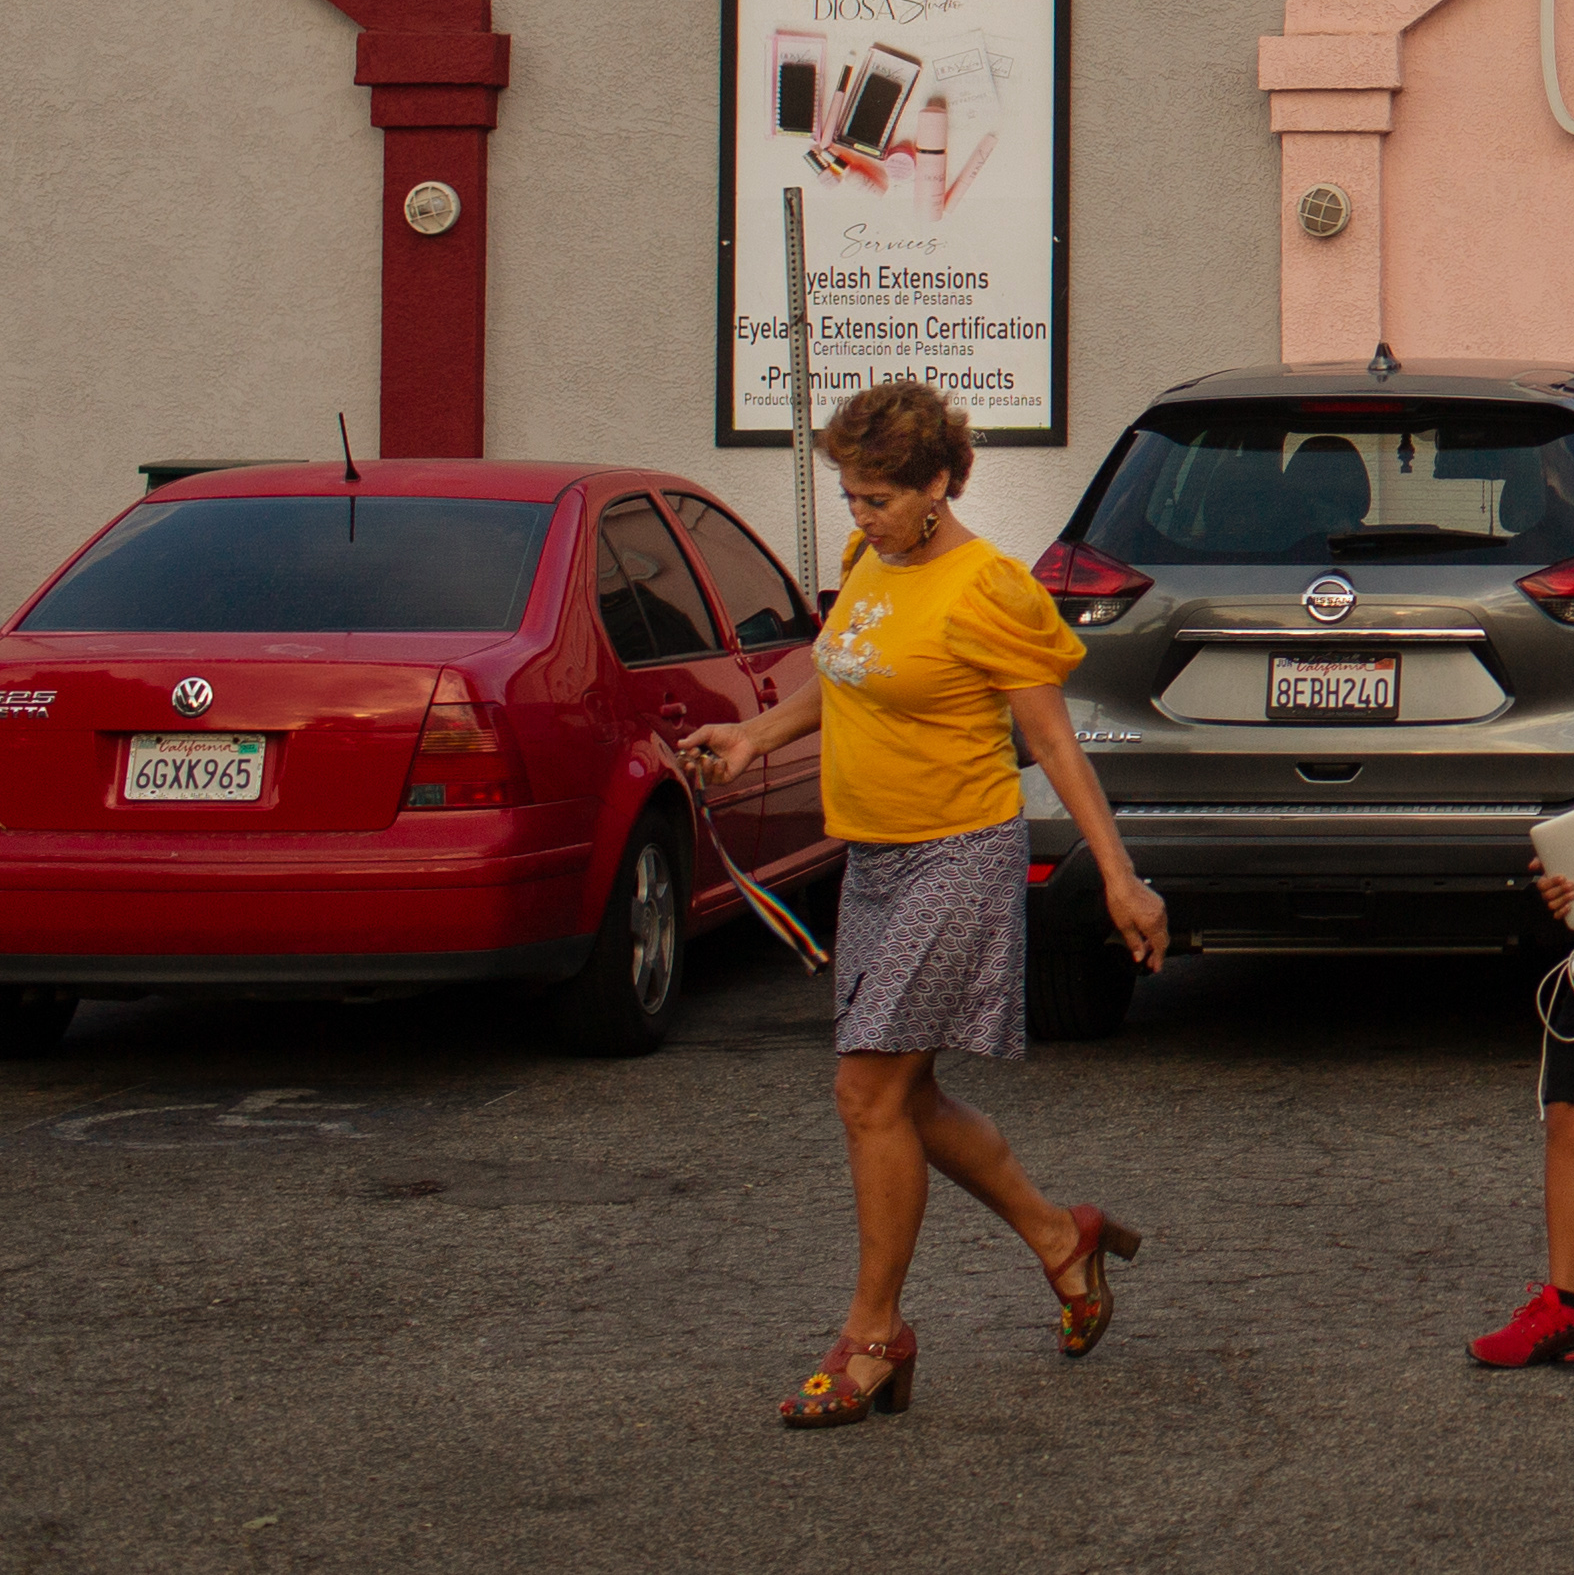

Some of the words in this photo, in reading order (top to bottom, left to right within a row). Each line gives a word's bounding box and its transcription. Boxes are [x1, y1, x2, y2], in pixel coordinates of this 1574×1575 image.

[807, 266, 870, 295] yelash
[879, 266, 989, 289] Extensions
[813, 291, 890, 306] Extensiones
[895, 291, 909, 305] de
[737, 316, 813, 345] Eyela
[821, 316, 919, 339] Extension
[926, 316, 1047, 339] Certification
[813, 341, 891, 356] Certificación
[896, 341, 911, 355] de
[768, 366, 861, 389] Prmium
[926, 366, 1014, 389] Products
[971, 394, 985, 406] de
[1297, 661, 1374, 677] California
[1276, 678, 1388, 709] 8EBH240
[0, 706, 49, 719] ETTA
[1074, 730, 1142, 743] OGUE
[158, 740, 239, 757] California
[135, 758, 251, 789] 6GXK965
